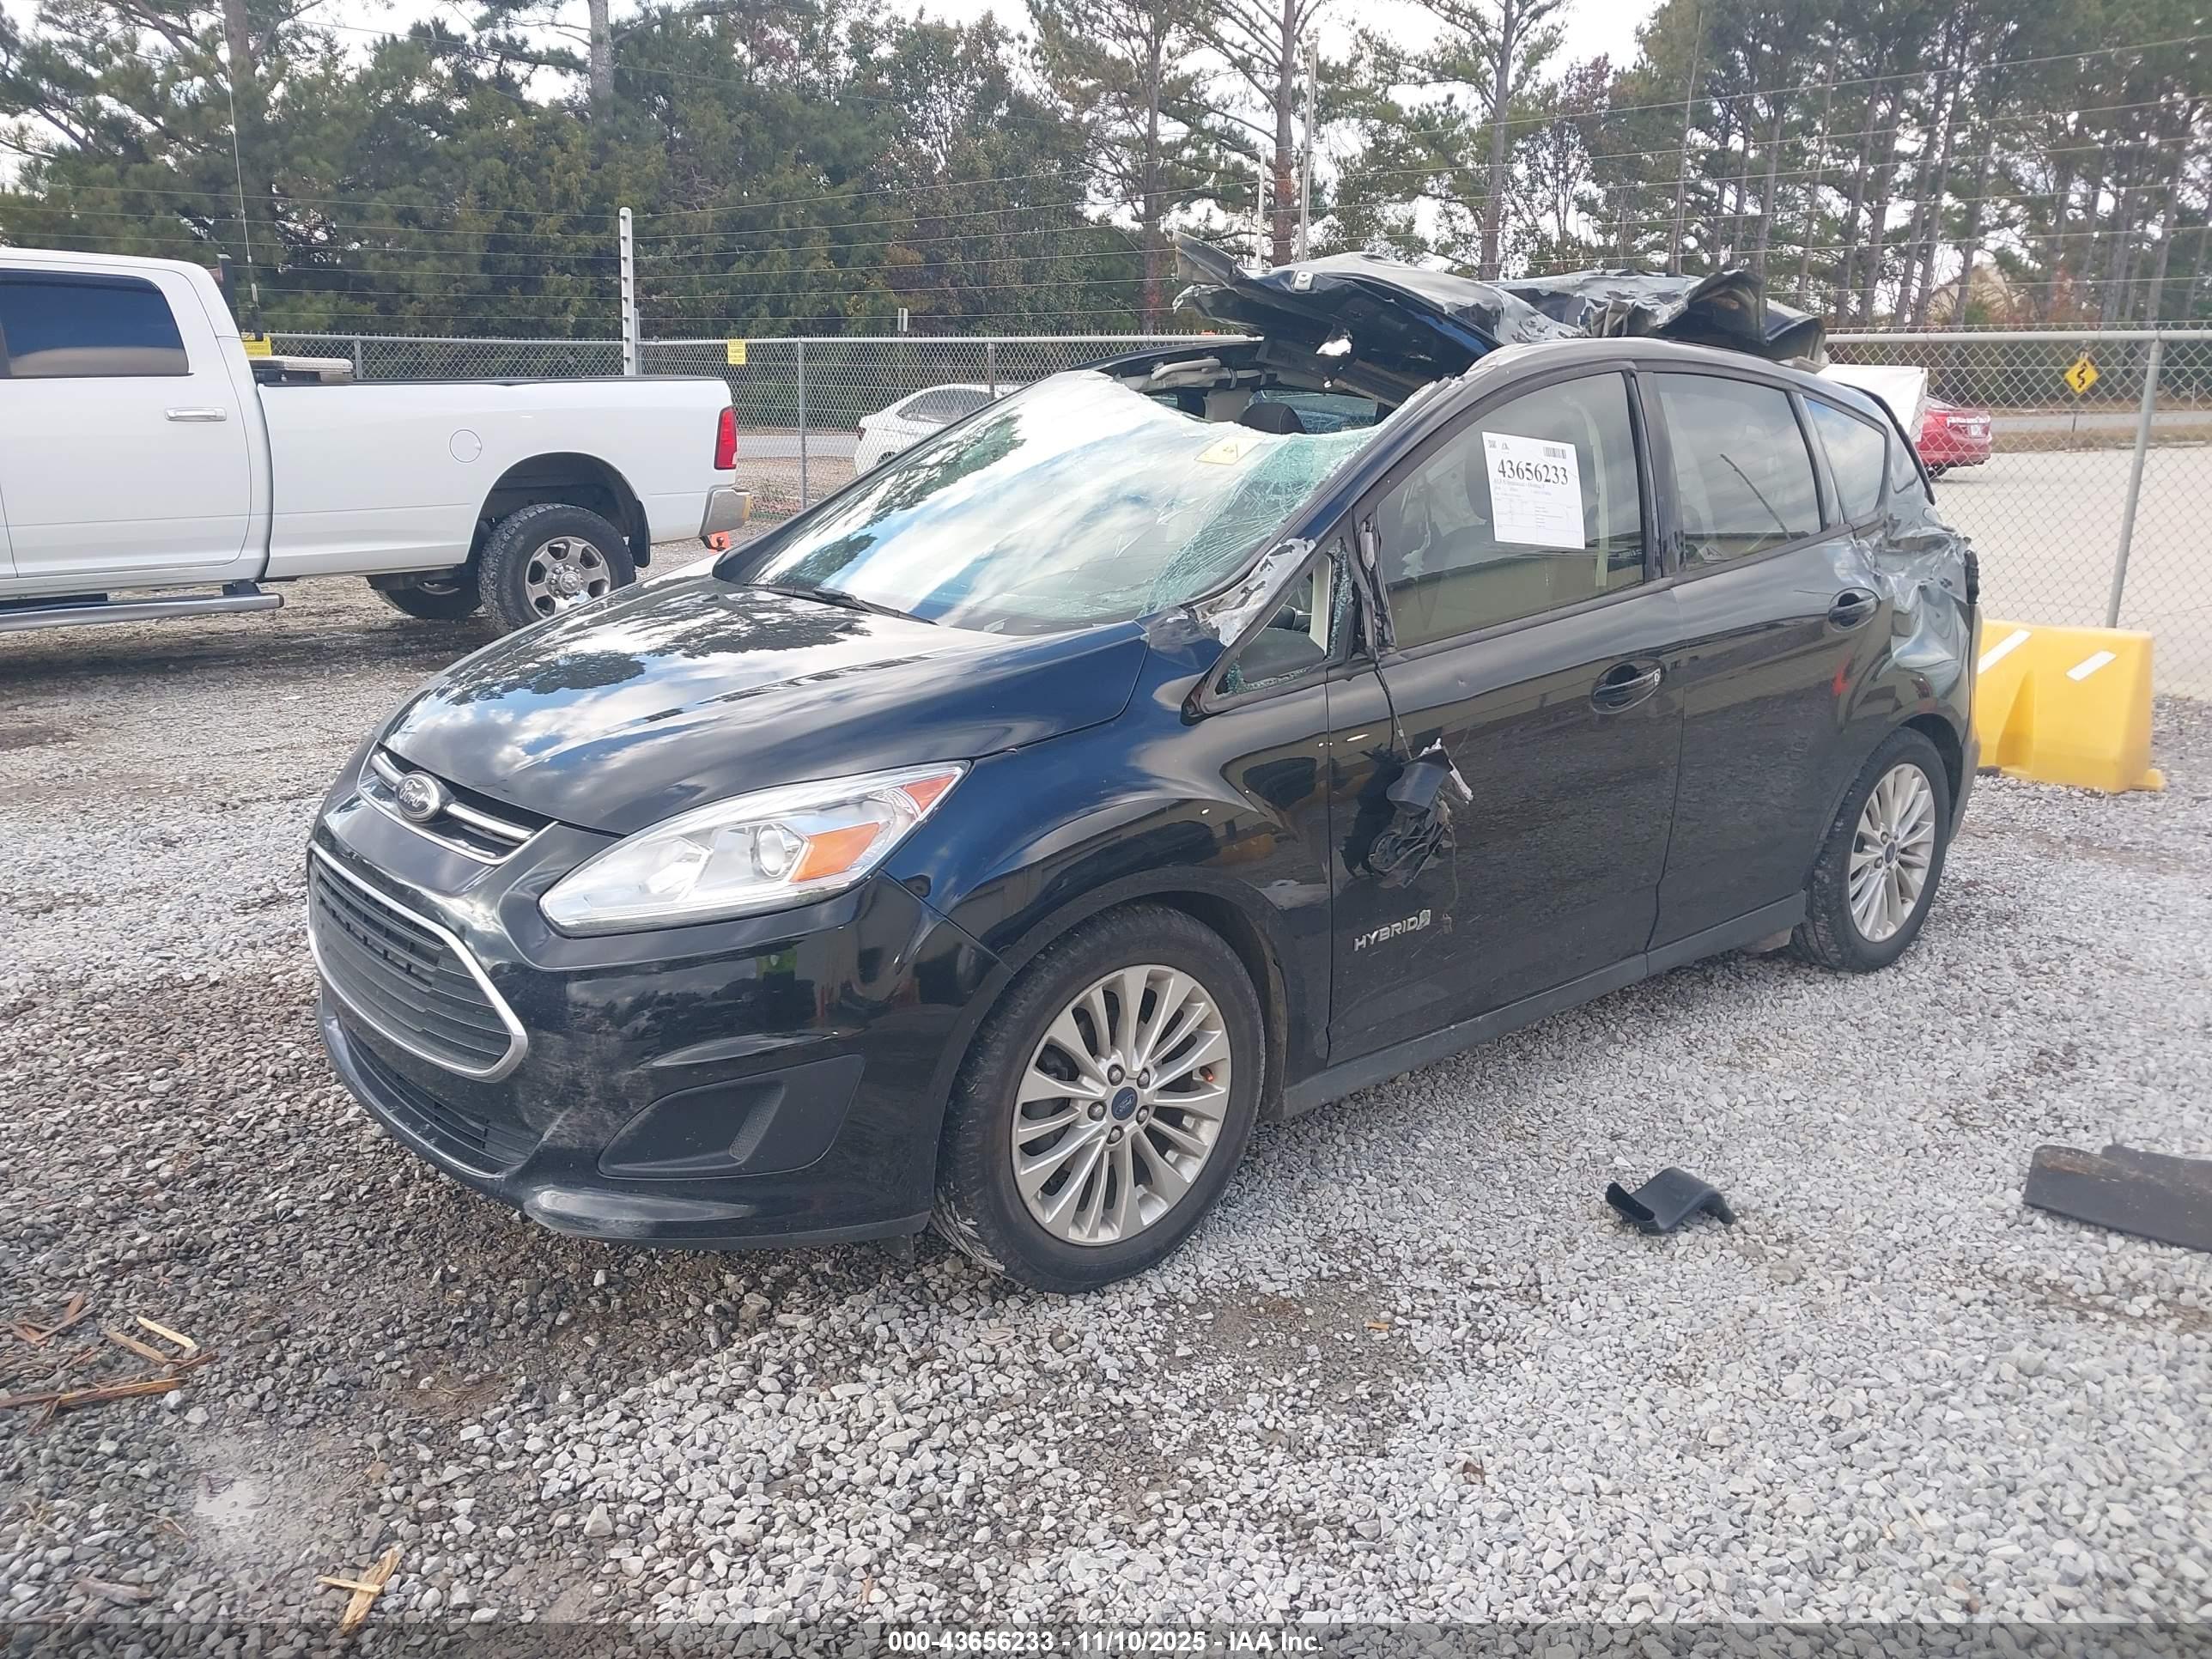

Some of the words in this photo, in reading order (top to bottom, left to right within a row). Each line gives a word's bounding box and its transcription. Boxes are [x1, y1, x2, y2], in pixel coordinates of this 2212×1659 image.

[1498, 459, 1568, 485] 43656233
[399, 779, 429, 807] Ford
[1353, 916, 1419, 951] HYBRID
